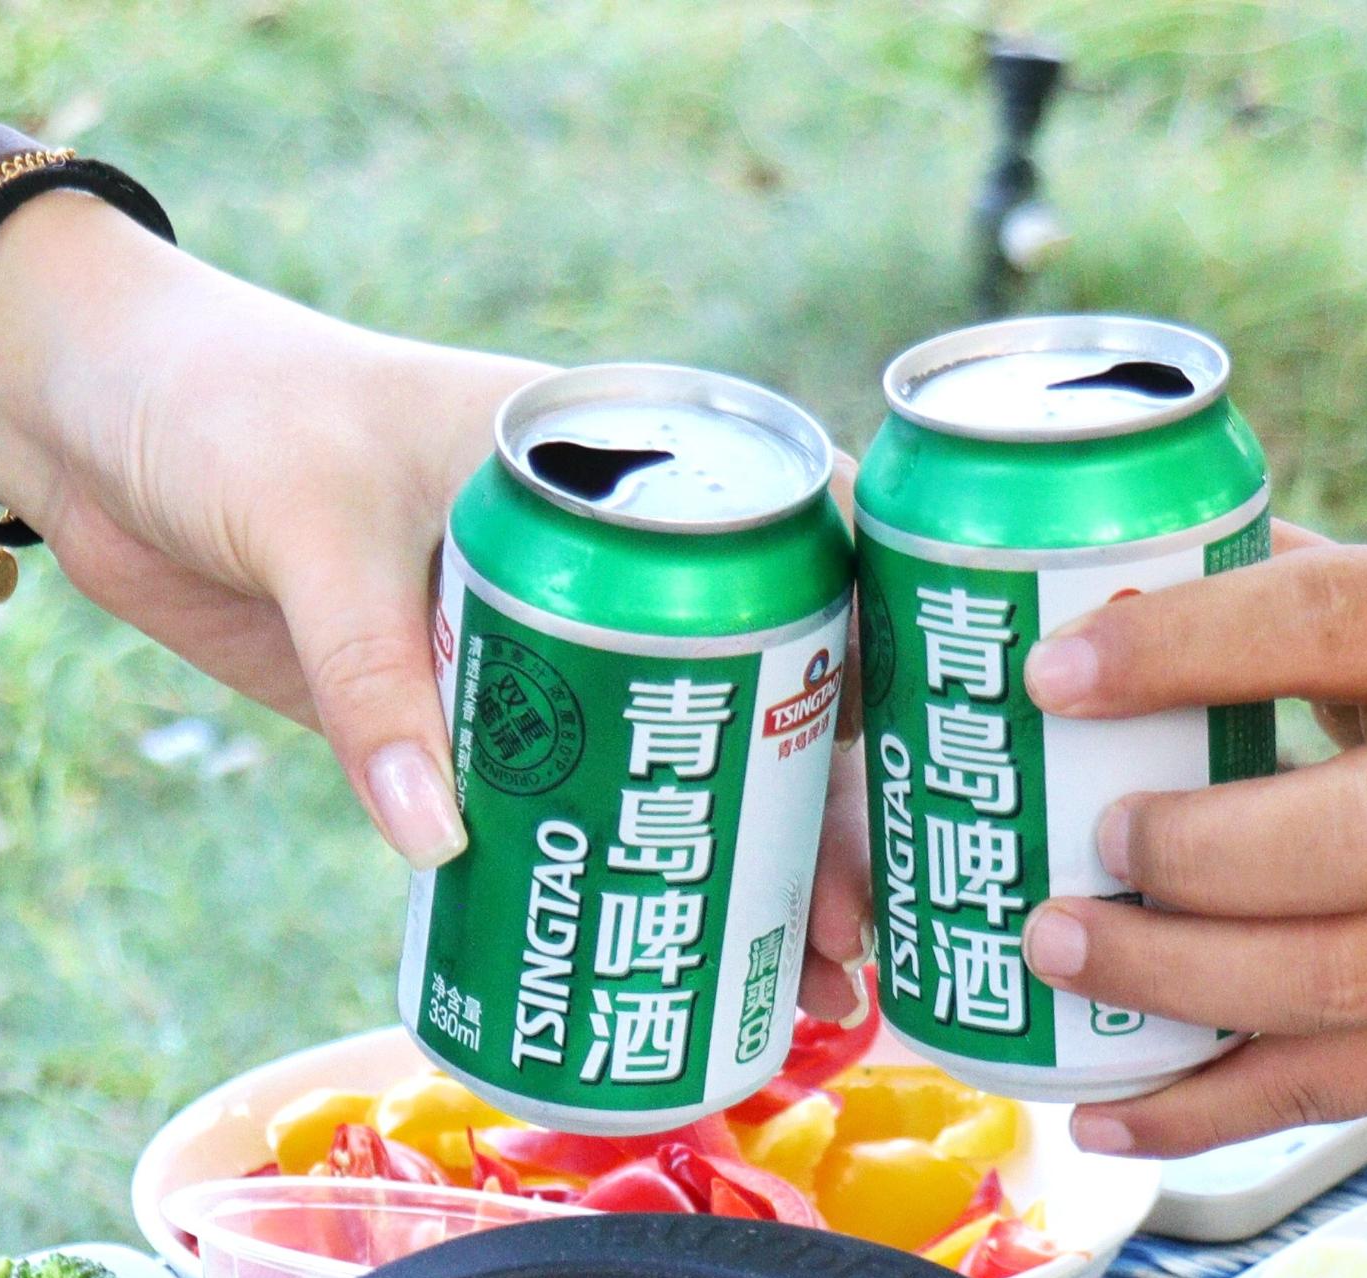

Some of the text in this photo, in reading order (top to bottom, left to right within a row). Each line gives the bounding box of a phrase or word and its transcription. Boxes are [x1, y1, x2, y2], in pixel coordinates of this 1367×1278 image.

[880, 731, 922, 1000] TSINGTAO
[432, 972, 482, 1027] 净含量
[510, 819, 589, 1070] TSINGTAO
[429, 997, 480, 1052] 330ml
